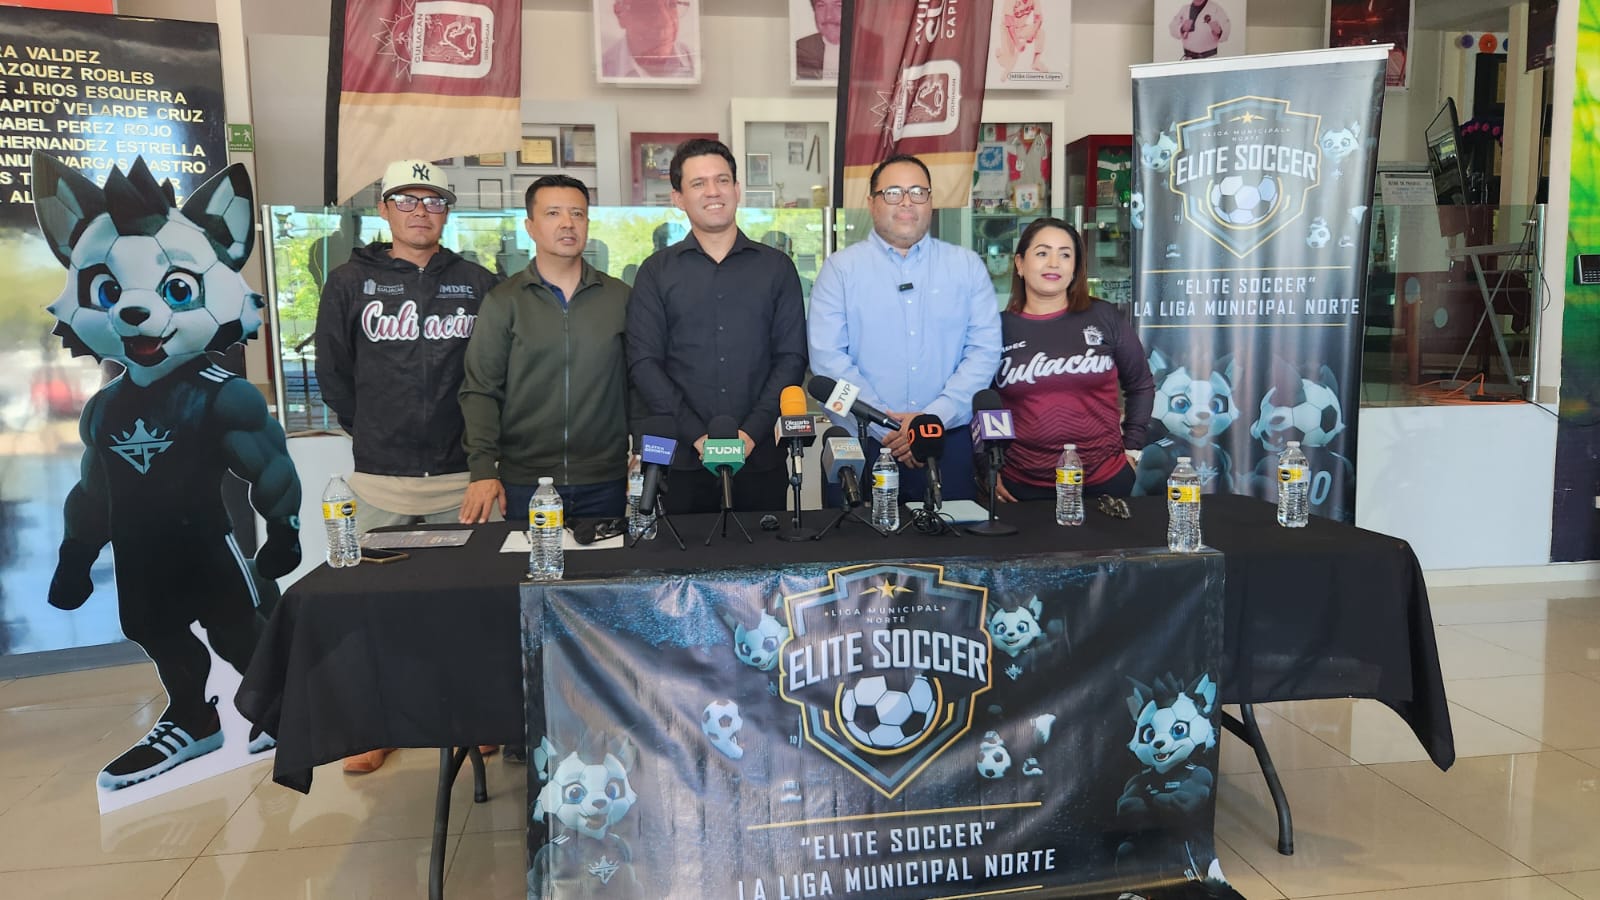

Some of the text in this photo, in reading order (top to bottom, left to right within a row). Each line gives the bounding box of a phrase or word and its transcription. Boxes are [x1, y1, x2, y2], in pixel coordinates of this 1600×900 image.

[25, 46, 101, 64] VALDEZ
[80, 67, 155, 85] ROBLES
[33, 82, 78, 97] RIOS
[85, 85, 187, 105] ESQUERRA
[63, 102, 148, 118] VELARDE
[157, 108, 204, 122] CRUZ
[57, 120, 115, 135] PEREZ
[124, 123, 171, 137] ROJO
[0, 134, 206, 157] HERNANDEZ ESTRELLA
[150, 158, 207, 174] ASTRO
[1176, 144, 1317, 186] ELITE SOCCER
[1134, 298, 1360, 317] LA LIGA MUNICIPAL NORTE
[994, 348, 1113, 388] Culiacán
[838, 383, 852, 401] TVP
[707, 446, 741, 455] TUDN
[831, 604, 940, 617] LIGA MUNICIPAL
[866, 616, 905, 624] NORTE
[789, 628, 987, 692] ELITE SOCCER
[801, 821, 996, 860] “ELITE SOCCER”
[779, 871, 833, 900] LIGA
[845, 857, 973, 893] MUNICIPAL
[985, 849, 1056, 878] NORTE
